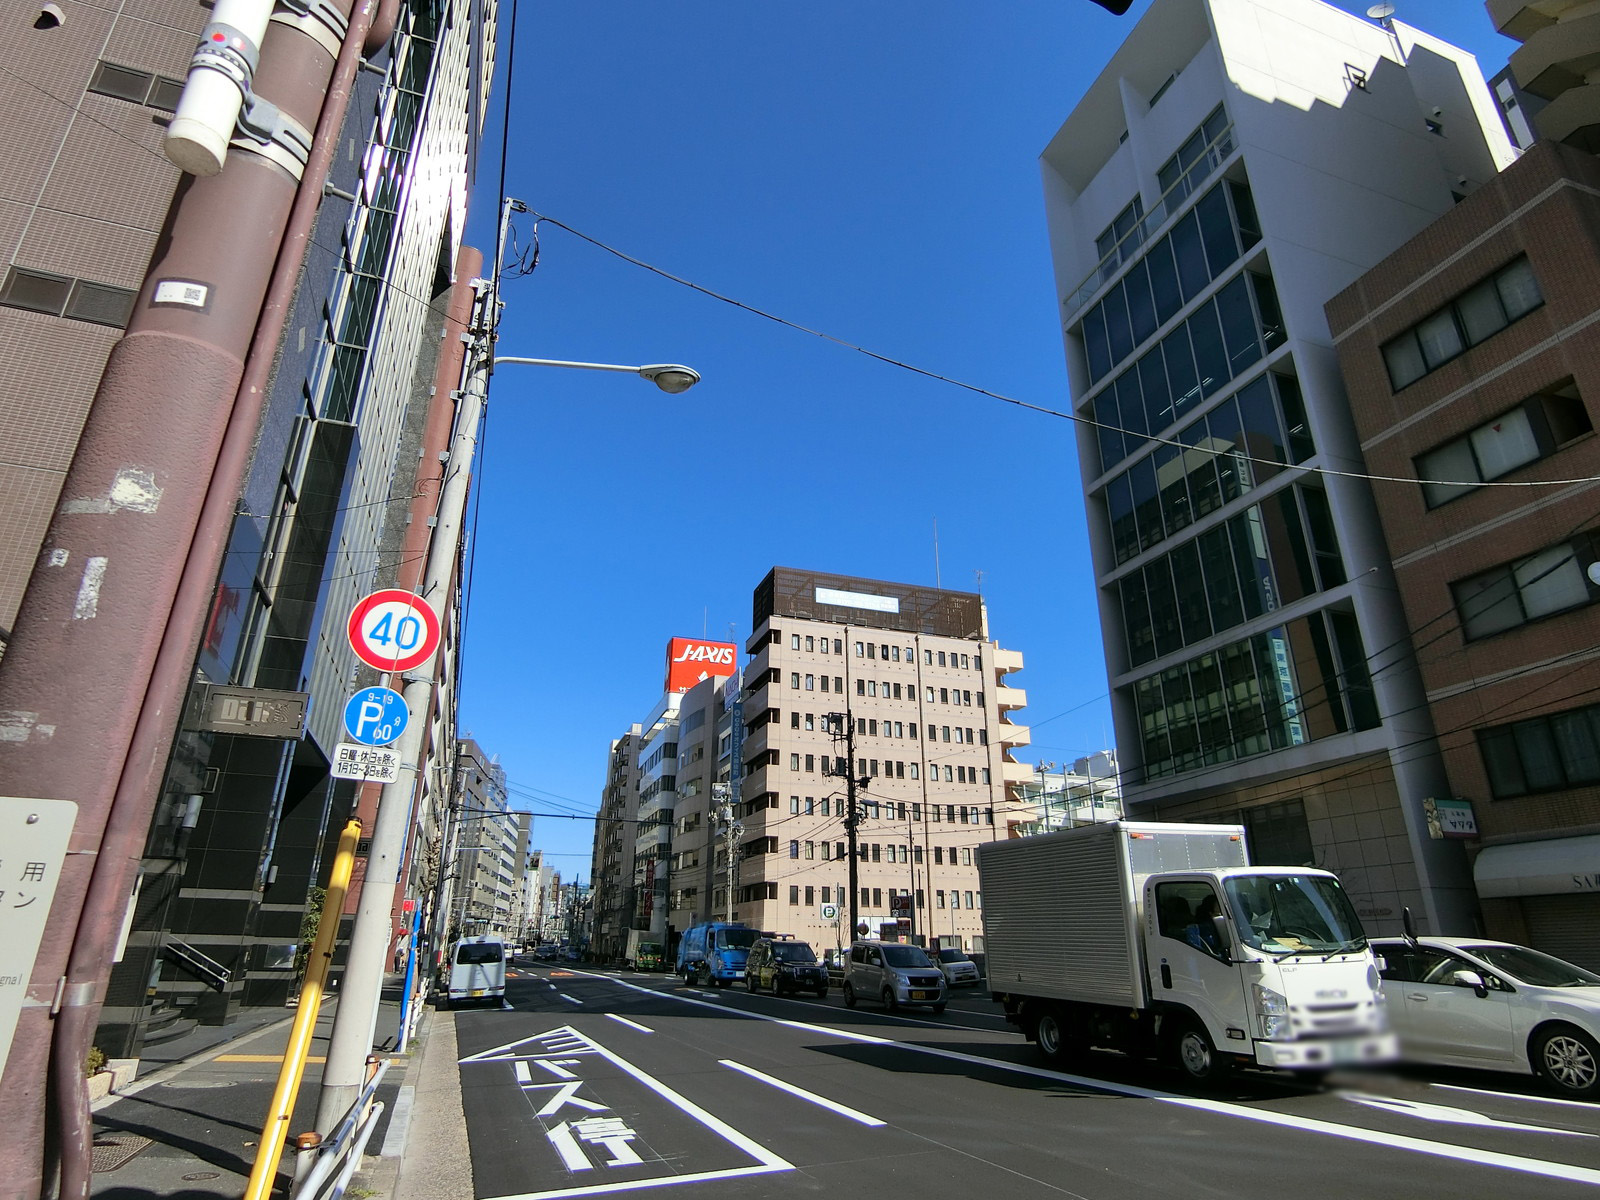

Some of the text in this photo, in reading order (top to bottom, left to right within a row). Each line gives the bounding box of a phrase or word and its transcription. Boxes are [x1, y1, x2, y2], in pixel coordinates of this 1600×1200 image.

[369, 611, 421, 650] 40
[674, 644, 734, 665] J-AXIS
[368, 692, 394, 705] 9-19
[355, 700, 385, 737] P
[394, 716, 402, 727] 分
[373, 724, 393, 741] 60
